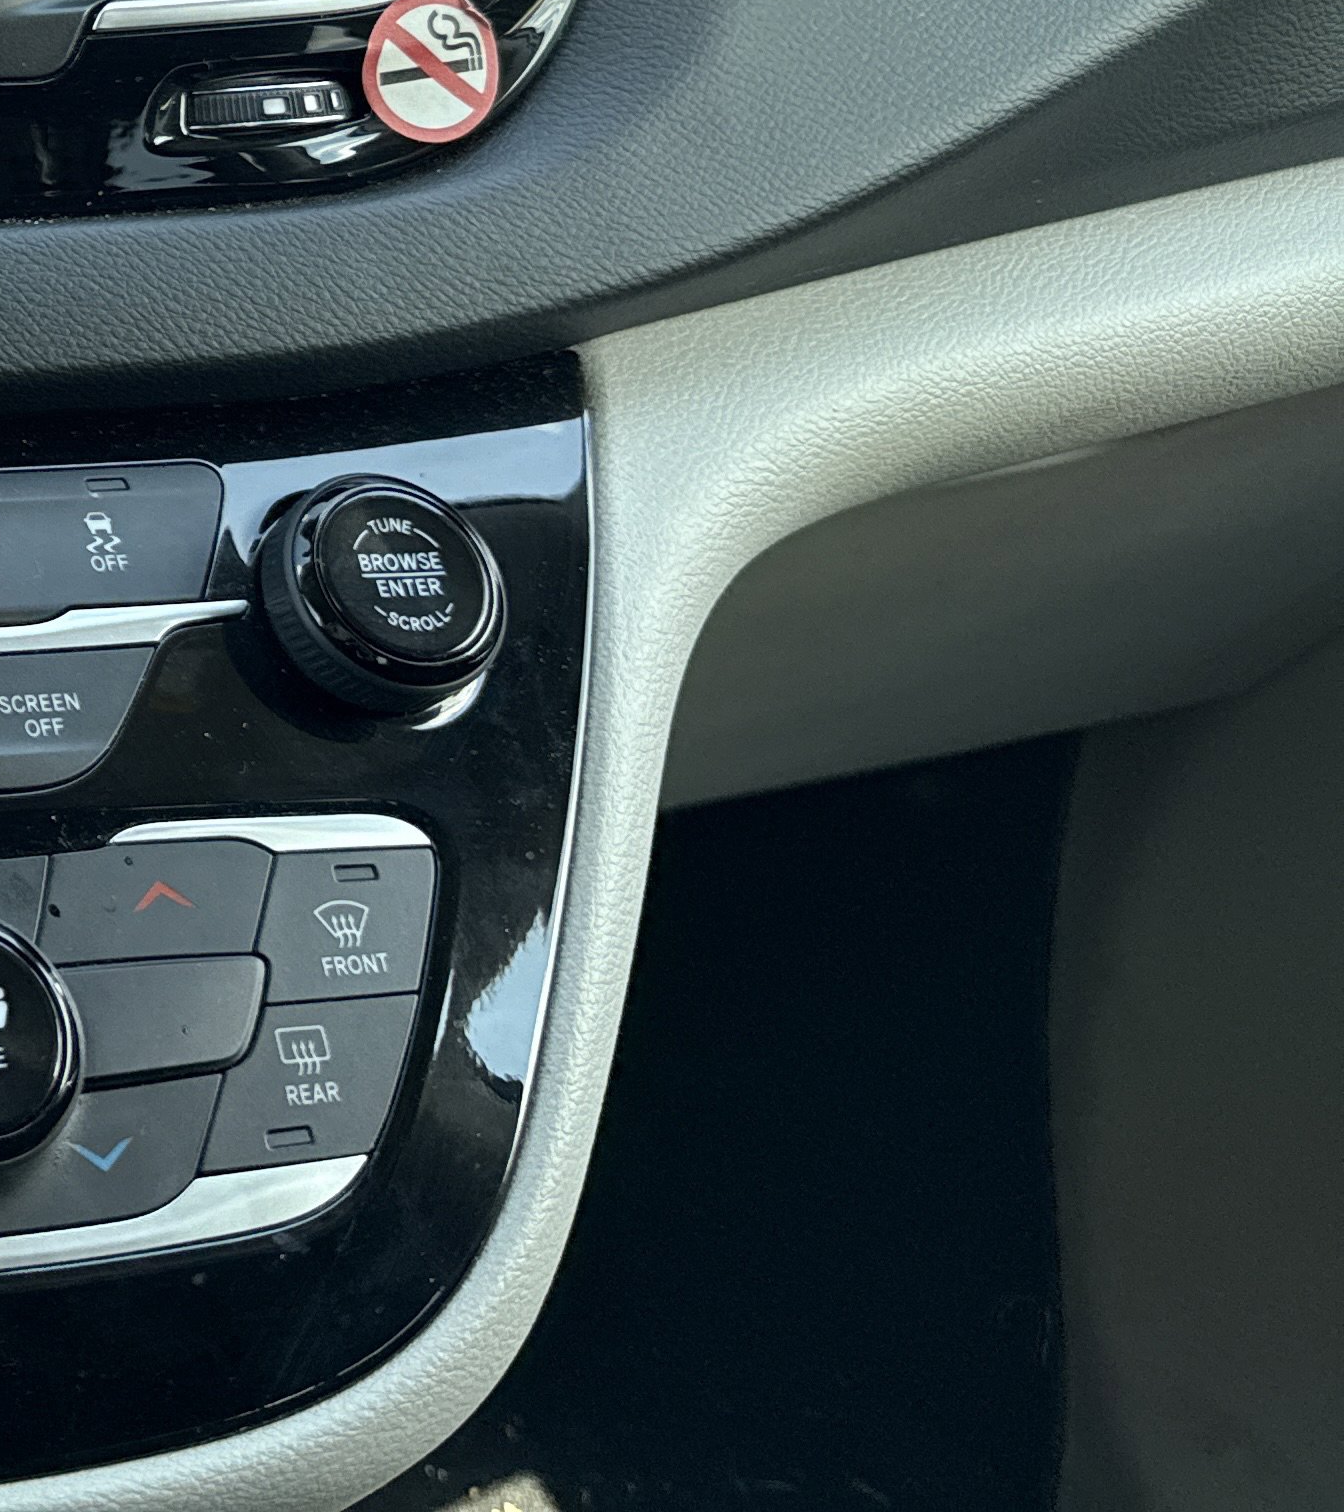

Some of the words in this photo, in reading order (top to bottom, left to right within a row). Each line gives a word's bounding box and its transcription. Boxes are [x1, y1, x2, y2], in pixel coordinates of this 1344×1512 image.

[366, 518, 413, 535] TUNE
[90, 553, 129, 572] OFF
[357, 551, 444, 571] BROWSE
[375, 578, 444, 597] ENTER
[387, 611, 452, 631] SCROLL
[25, 718, 63, 737] OFF
[322, 953, 387, 976] FRONT
[286, 1082, 340, 1105] REAR
